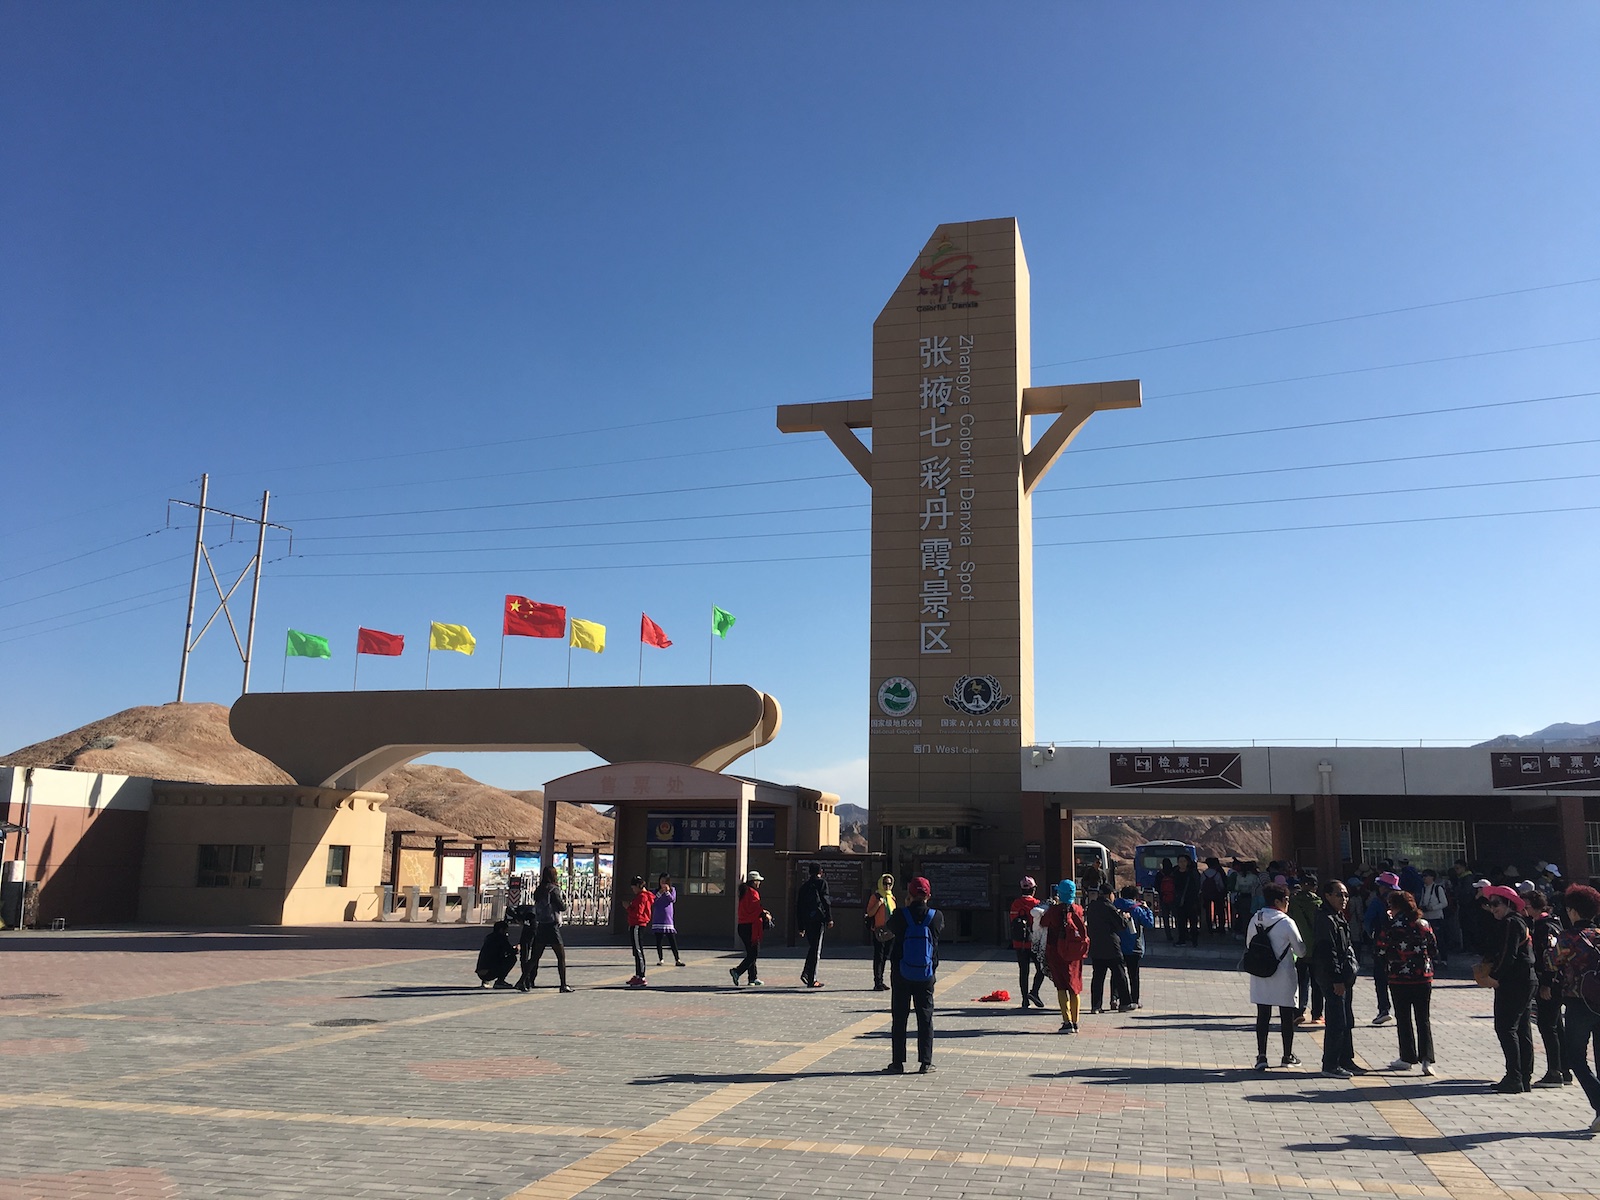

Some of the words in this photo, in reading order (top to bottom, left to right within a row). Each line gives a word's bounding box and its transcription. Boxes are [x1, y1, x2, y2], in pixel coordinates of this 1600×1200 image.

[916, 303, 947, 313] Colorful
[952, 301, 979, 310] Danxia
[956, 335, 974, 405] Zhangye
[959, 413, 975, 479] Colorful
[919, 335, 954, 654] 张掖七彩丹霞景区
[959, 488, 975, 546] Danxia
[956, 561, 976, 601] Spot
[896, 727, 921, 736] Geopark
[913, 744, 931, 754] 西门
[935, 745, 959, 754] West
[1158, 755, 1210, 768] 检票口
[601, 775, 684, 795] 售票处
[681, 819, 764, 829] 丹霞景区派出西门
